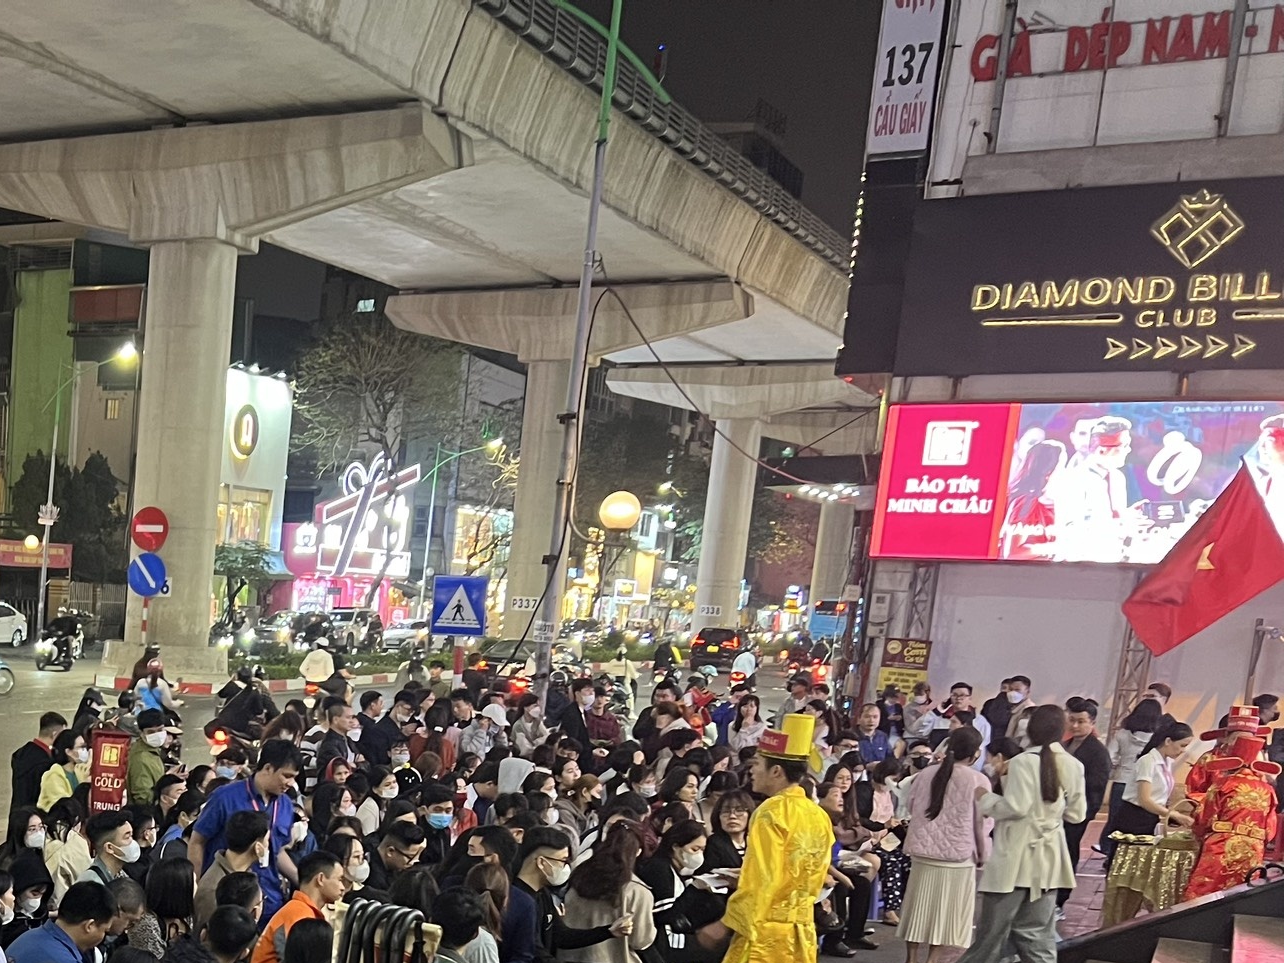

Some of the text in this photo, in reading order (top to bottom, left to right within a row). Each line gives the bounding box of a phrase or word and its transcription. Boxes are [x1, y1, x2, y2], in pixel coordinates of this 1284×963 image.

[1064, 6, 1132, 72] DÉP
[1143, 10, 1231, 65] NAM
[882, 42, 935, 88] 137
[971, 276, 1174, 311] DIAMOND
[1135, 308, 1217, 328] CLUB
[904, 474, 981, 494] BẢO TÍN
[886, 494, 993, 514] MINH CHÂU
[512, 598, 538, 609] P337
[700, 606, 721, 616] P338
[94, 776, 122, 789] GOLD
[93, 801, 121, 812] TRUNG
